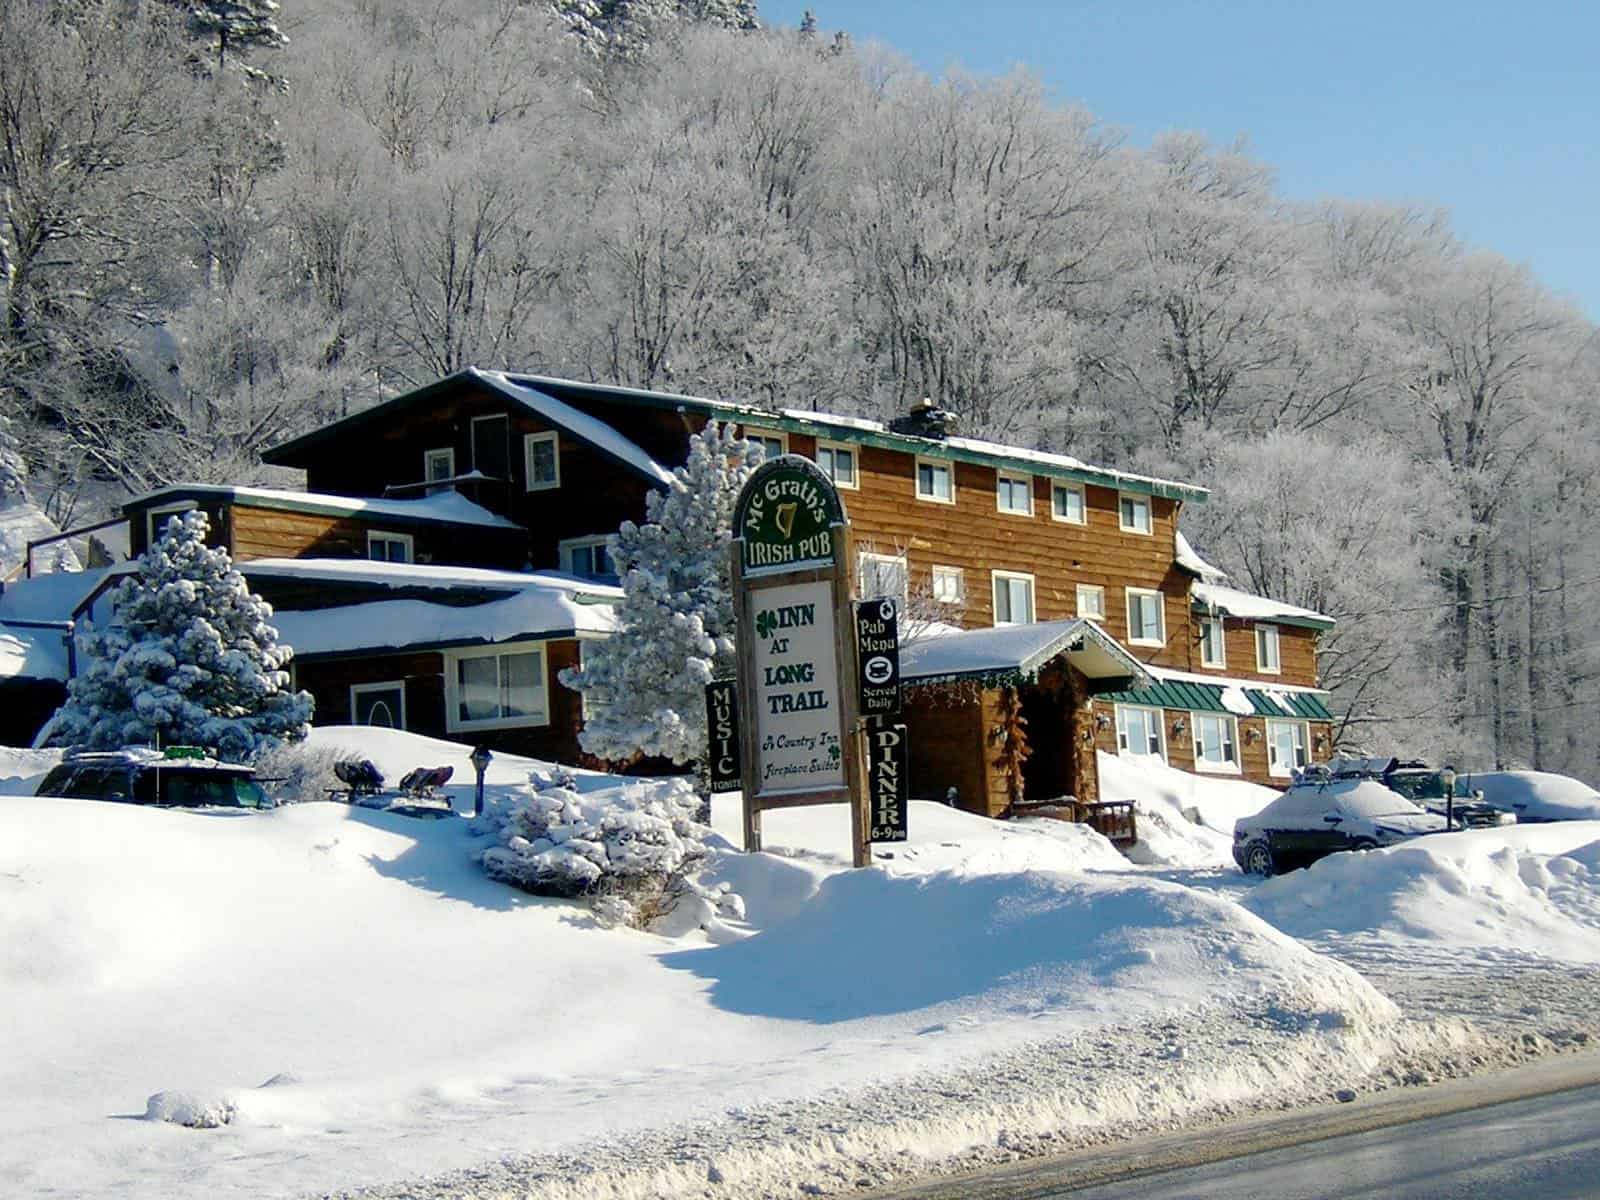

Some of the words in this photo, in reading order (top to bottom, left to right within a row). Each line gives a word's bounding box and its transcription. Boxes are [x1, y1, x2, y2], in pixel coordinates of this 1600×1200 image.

[750, 541, 794, 565] IRISH
[800, 531, 831, 559] PUB
[778, 603, 815, 628] INN
[860, 619, 886, 635] Pub
[770, 639, 789, 654] AT
[861, 638, 895, 653] Menu
[764, 662, 815, 686] LONG
[767, 690, 829, 714] TRAIL
[713, 687, 733, 775] MUSIC
[776, 734, 817, 750] Country
[876, 731, 900, 825] DINNER
